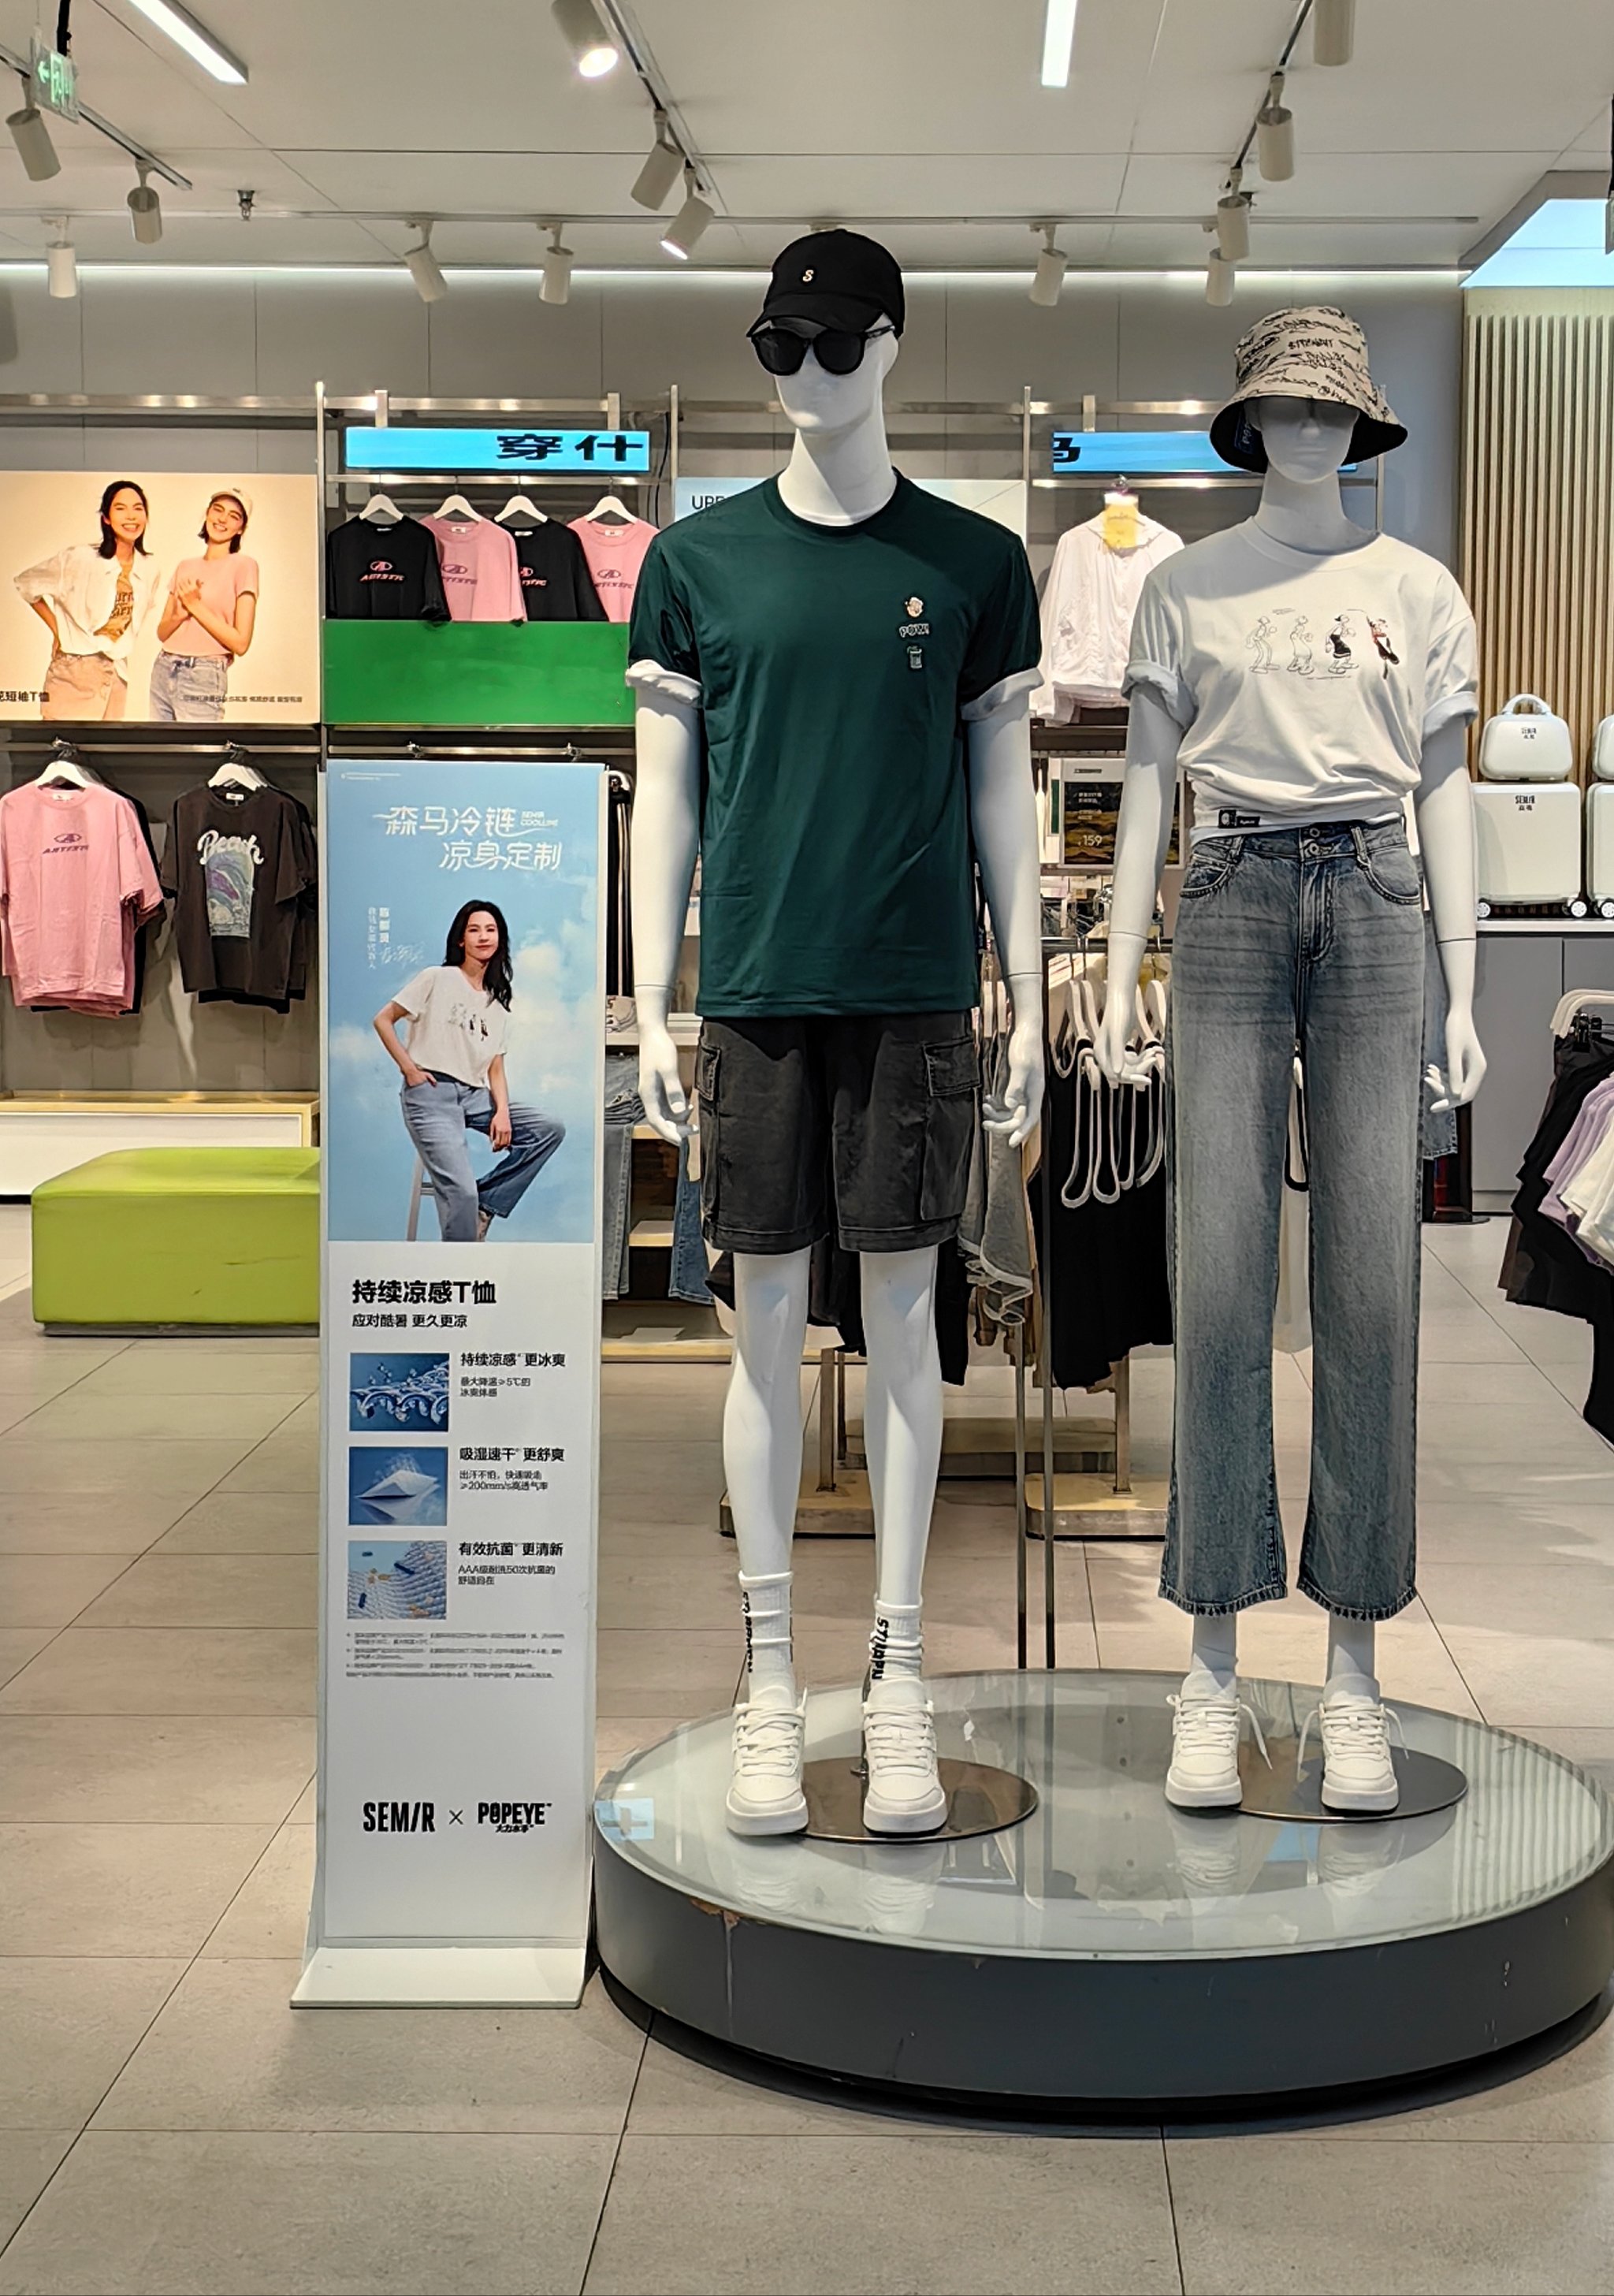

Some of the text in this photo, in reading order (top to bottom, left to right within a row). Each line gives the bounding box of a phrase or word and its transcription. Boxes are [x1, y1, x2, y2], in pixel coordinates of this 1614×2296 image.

[802, 269, 814, 282] S
[496, 433, 644, 462] 穿什
[374, 806, 517, 837] 森马冷链
[439, 839, 563, 871] 凉身定制
[352, 1279, 497, 1304] 持续凉感T恤
[352, 1314, 467, 1328] 应对酷暑 更久更凉
